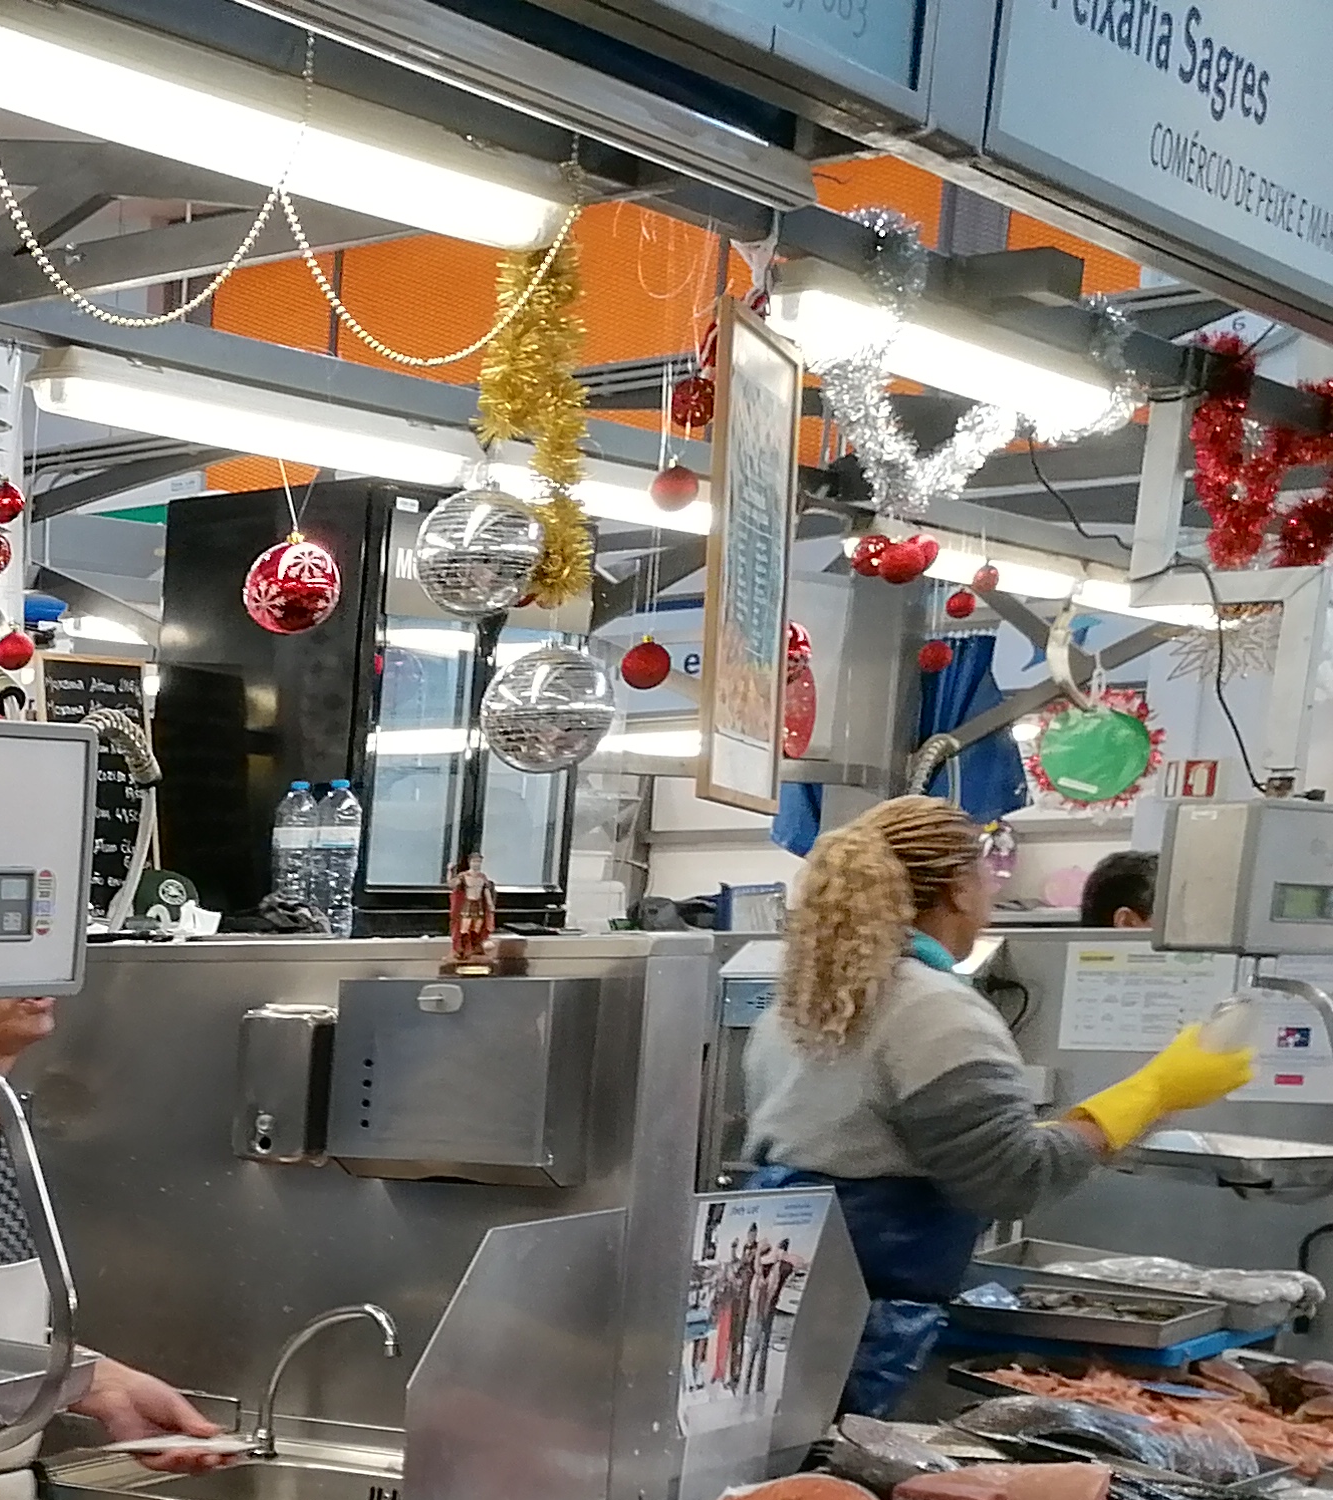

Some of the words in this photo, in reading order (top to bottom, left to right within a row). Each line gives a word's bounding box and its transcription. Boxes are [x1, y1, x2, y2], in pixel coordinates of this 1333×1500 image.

[1179, 5, 1270, 125] Sagres
[1150, 122, 1233, 201] COMÉRCIO
[1233, 165, 1256, 213] DE
[1256, 177, 1296, 233] PEIXE
[1297, 198, 1308, 240] E
[1308, 204, 1333, 253] MA
